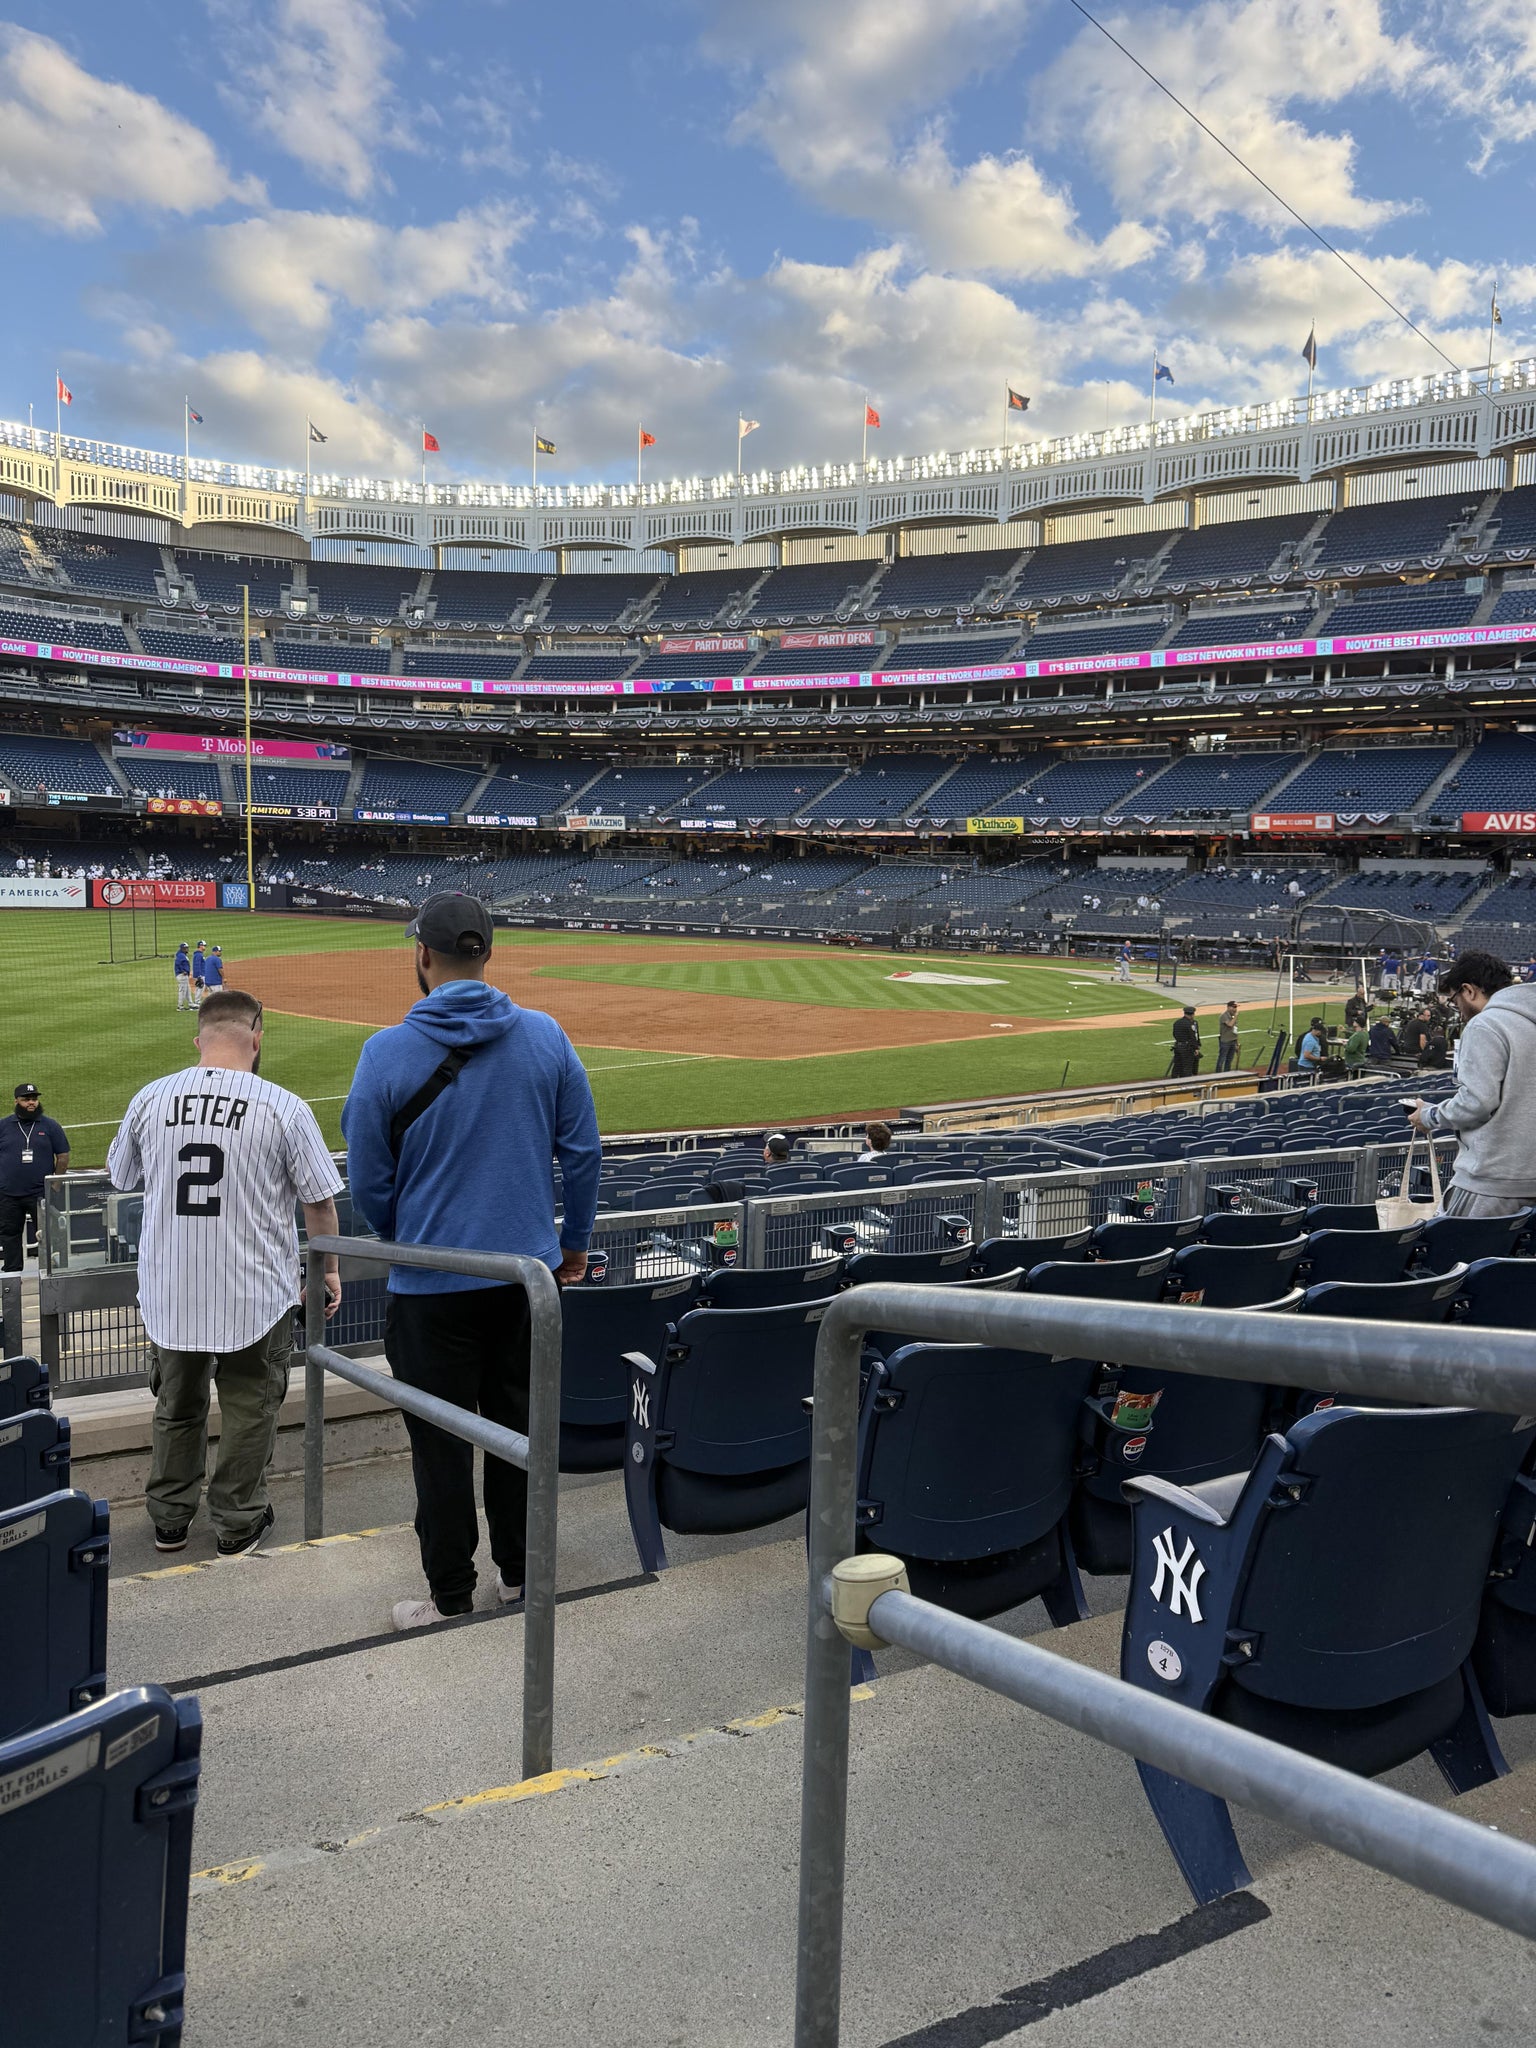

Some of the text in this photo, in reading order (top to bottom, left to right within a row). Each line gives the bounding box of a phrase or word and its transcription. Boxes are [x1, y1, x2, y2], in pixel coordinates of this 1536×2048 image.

[695, 640, 721, 651] PARTY
[722, 638, 744, 650] DECK
[818, 634, 847, 646] PARTY
[848, 632, 871, 644] DECK
[1346, 627, 1536, 650] NOW THE BEST NETWORK IN AMERICA
[2, 642, 27, 653] GAME
[1177, 644, 1304, 662] BEST NETWORK IN THE GAME
[63, 651, 208, 673] NOW THE BEST NETWORK IN AMERICA
[1049, 656, 1139, 672] IT'S BETTER OVER HERE
[243, 669, 328, 682] I'S BETTER OVER HERE
[753, 676, 850, 687] BEST NETWORK IN THE GAME
[882, 667, 1016, 683] NOW THE BEST NETWORK IN AMERICA
[361, 677, 462, 690] BEST NETWORK IN THE GAME
[493, 683, 615, 693] NOW THE BEST NETWORK IN AMERICA
[218, 739, 264, 754] Moble
[297, 808, 331, 819] 5:38 PM
[373, 812, 395, 821] ALDS
[413, 814, 446, 822] Booking.com
[468, 815, 484, 825] BLUE
[485, 816, 500, 825] JAYS
[508, 816, 537, 825] YANKEES
[589, 818, 622, 827] AMAZING
[972, 818, 1019, 831] Nathan's
[1483, 813, 1536, 830] AVIS
[8, 888, 60, 898] AMERICA
[128, 884, 154, 896] F.W.
[158, 884, 206, 897] WEBB
[292, 896, 317, 905] POSTSEASON
[508, 917, 535, 925] Booking.com
[165, 1094, 249, 1131] JETER
[176, 1143, 224, 1217] 2
[632, 1377, 649, 1430] NY
[2, 1530, 28, 1546] BALLS
[1150, 1526, 1206, 1624] NY
[1160, 1643, 1174, 1657] 127B
[1159, 1659, 1168, 1672] 4
[18, 1766, 45, 1787] FOR
[25, 1765, 69, 1795] BALLS
